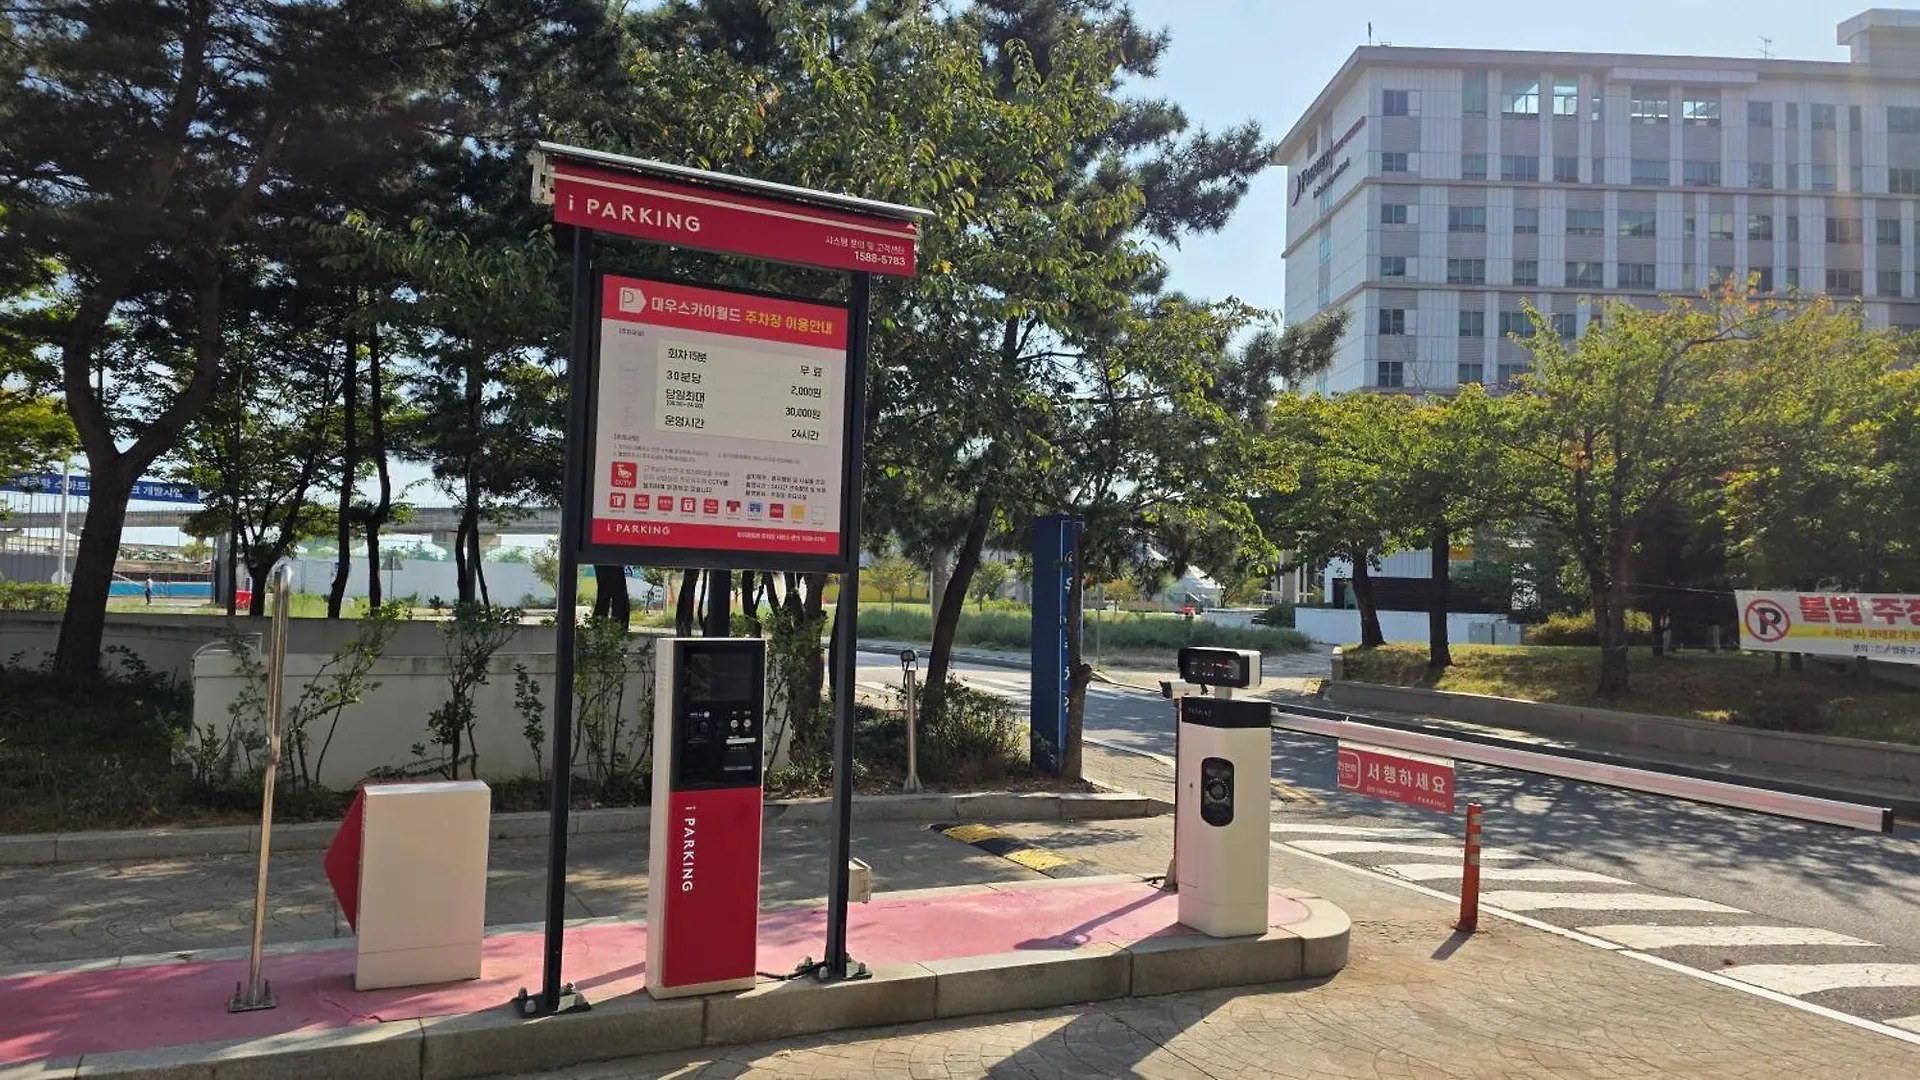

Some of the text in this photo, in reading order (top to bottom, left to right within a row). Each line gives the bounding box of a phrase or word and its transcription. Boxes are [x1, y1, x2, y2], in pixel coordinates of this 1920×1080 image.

[586, 198, 701, 233] PARKING
[854, 251, 906, 266] 1588-5783
[651, 297, 833, 335] 대우스카이월드 주차장 이용안내
[668, 348, 707, 363] 회차15분
[666, 370, 702, 384] 30분당
[666, 388, 705, 403] 당일최대
[785, 406, 821, 420] 30,000원
[664, 414, 705, 429] 운영시간
[791, 428, 820, 441] 24시간
[143, 486, 183, 498] 개발사업
[616, 523, 671, 535] PARKING
[1798, 596, 1863, 624] 불법
[1367, 762, 1446, 794] 서행하세요
[681, 817, 696, 892] PARKING
